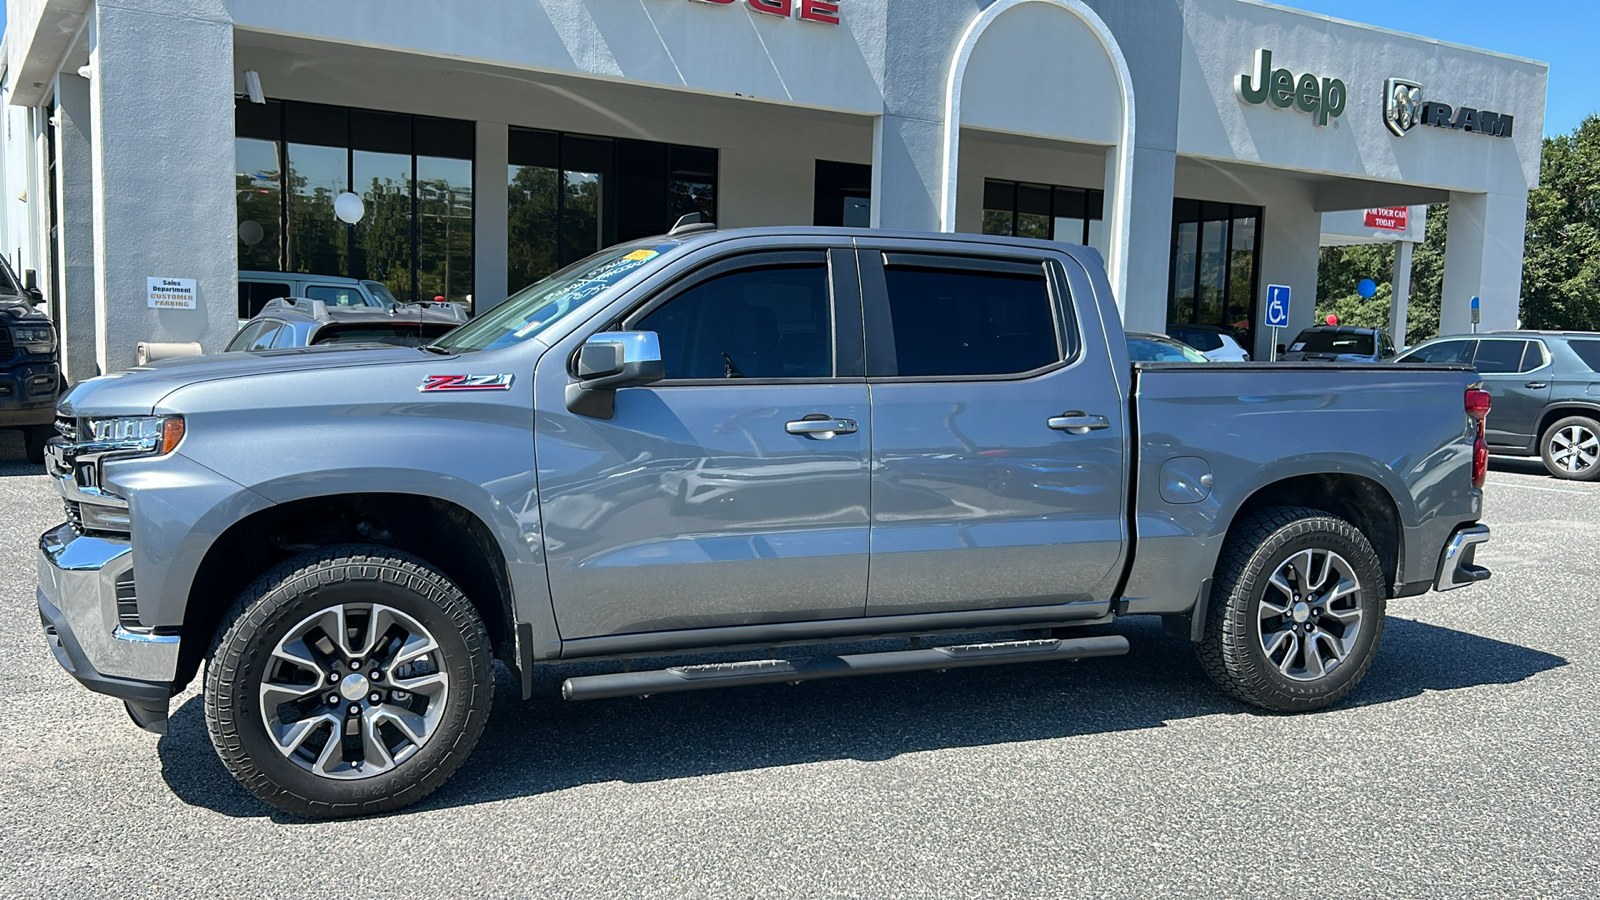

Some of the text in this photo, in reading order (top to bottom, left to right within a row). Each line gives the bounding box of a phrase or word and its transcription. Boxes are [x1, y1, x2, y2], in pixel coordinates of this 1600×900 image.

[1234, 48, 1346, 127] Jeep
[1421, 101, 1514, 137] RAM
[1375, 218, 1395, 227] TODAY
[1378, 208, 1394, 217] YOUR
[1394, 210, 1406, 218] CAR
[417, 373, 516, 393] Z71
